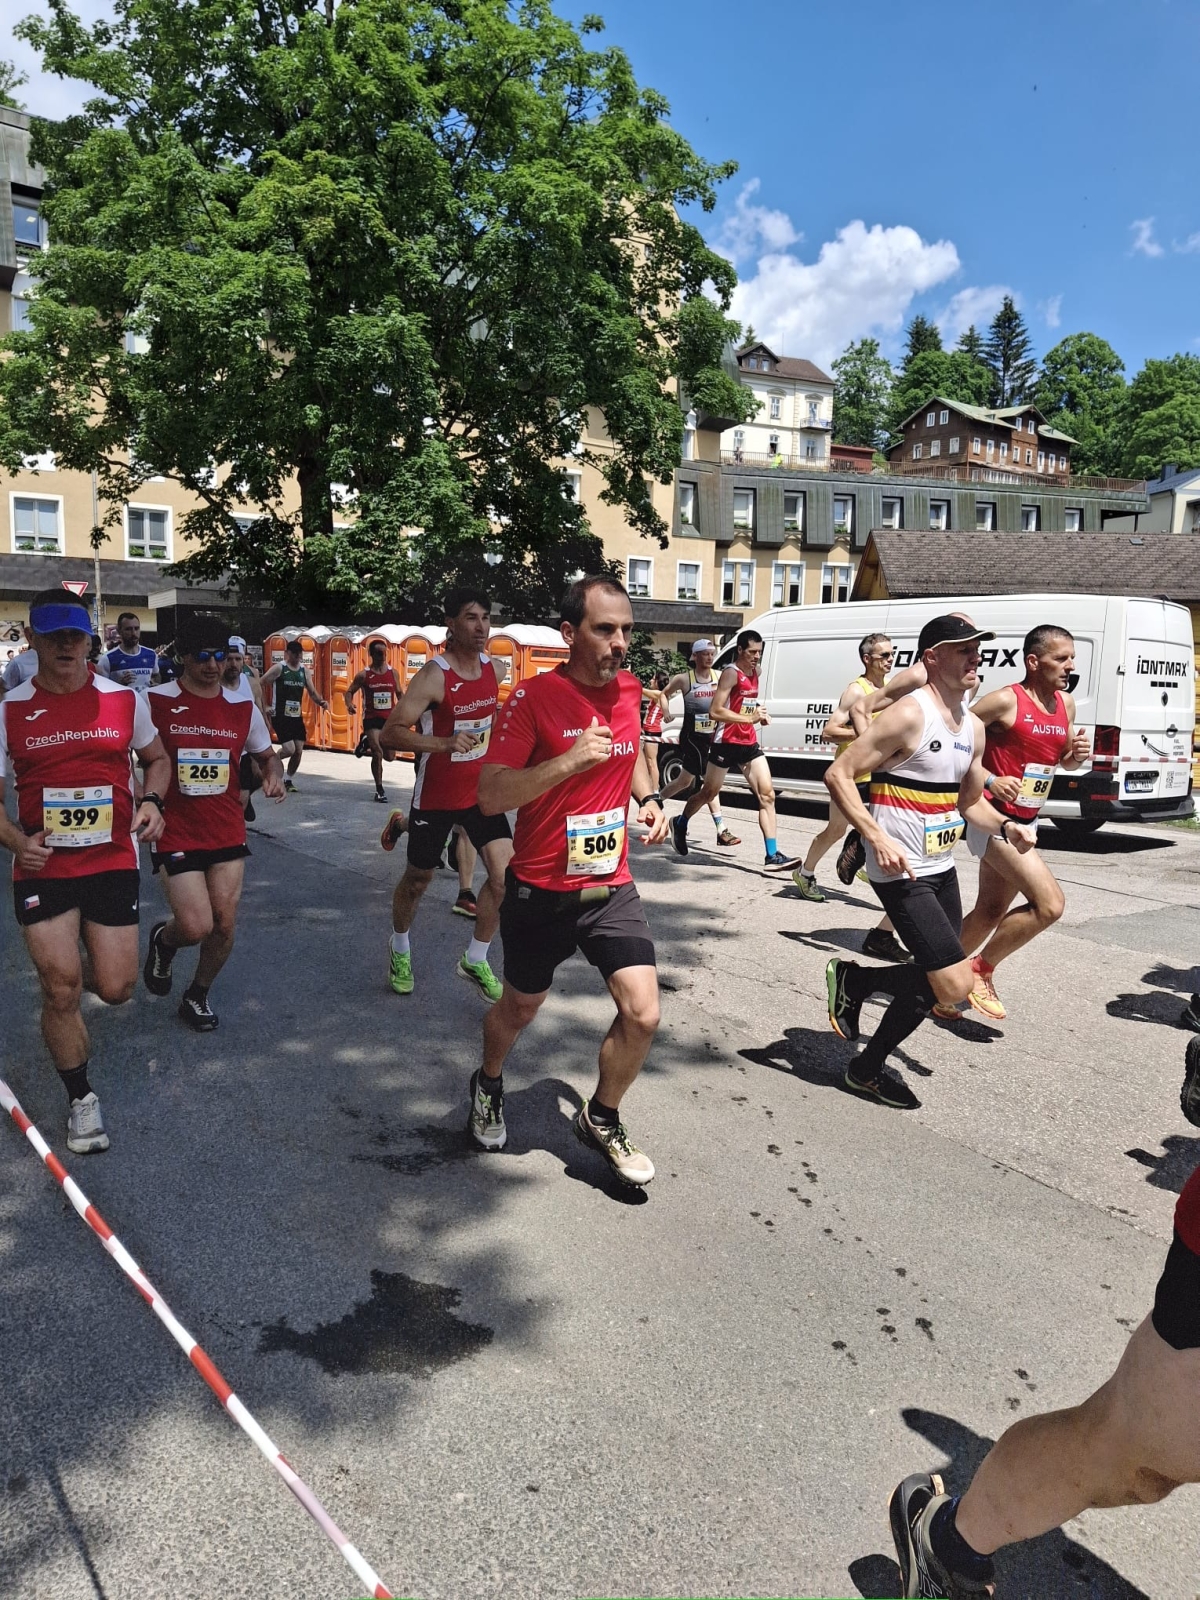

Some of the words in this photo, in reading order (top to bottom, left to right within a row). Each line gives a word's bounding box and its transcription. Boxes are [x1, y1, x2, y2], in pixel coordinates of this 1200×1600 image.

[1136, 655, 1187, 677] iONTMAX
[807, 703, 834, 715] FUEL
[169, 723, 238, 739] CzechRepublic
[562, 728, 583, 738] JAKO
[1032, 724, 1066, 736] AUSTRIA
[25, 727, 120, 750] CzechRepublic
[190, 765, 218, 779] 265
[1033, 780, 1049, 793] 88
[59, 807, 99, 827] 399
[583, 831, 617, 856] 506
[937, 828, 956, 847] 106
